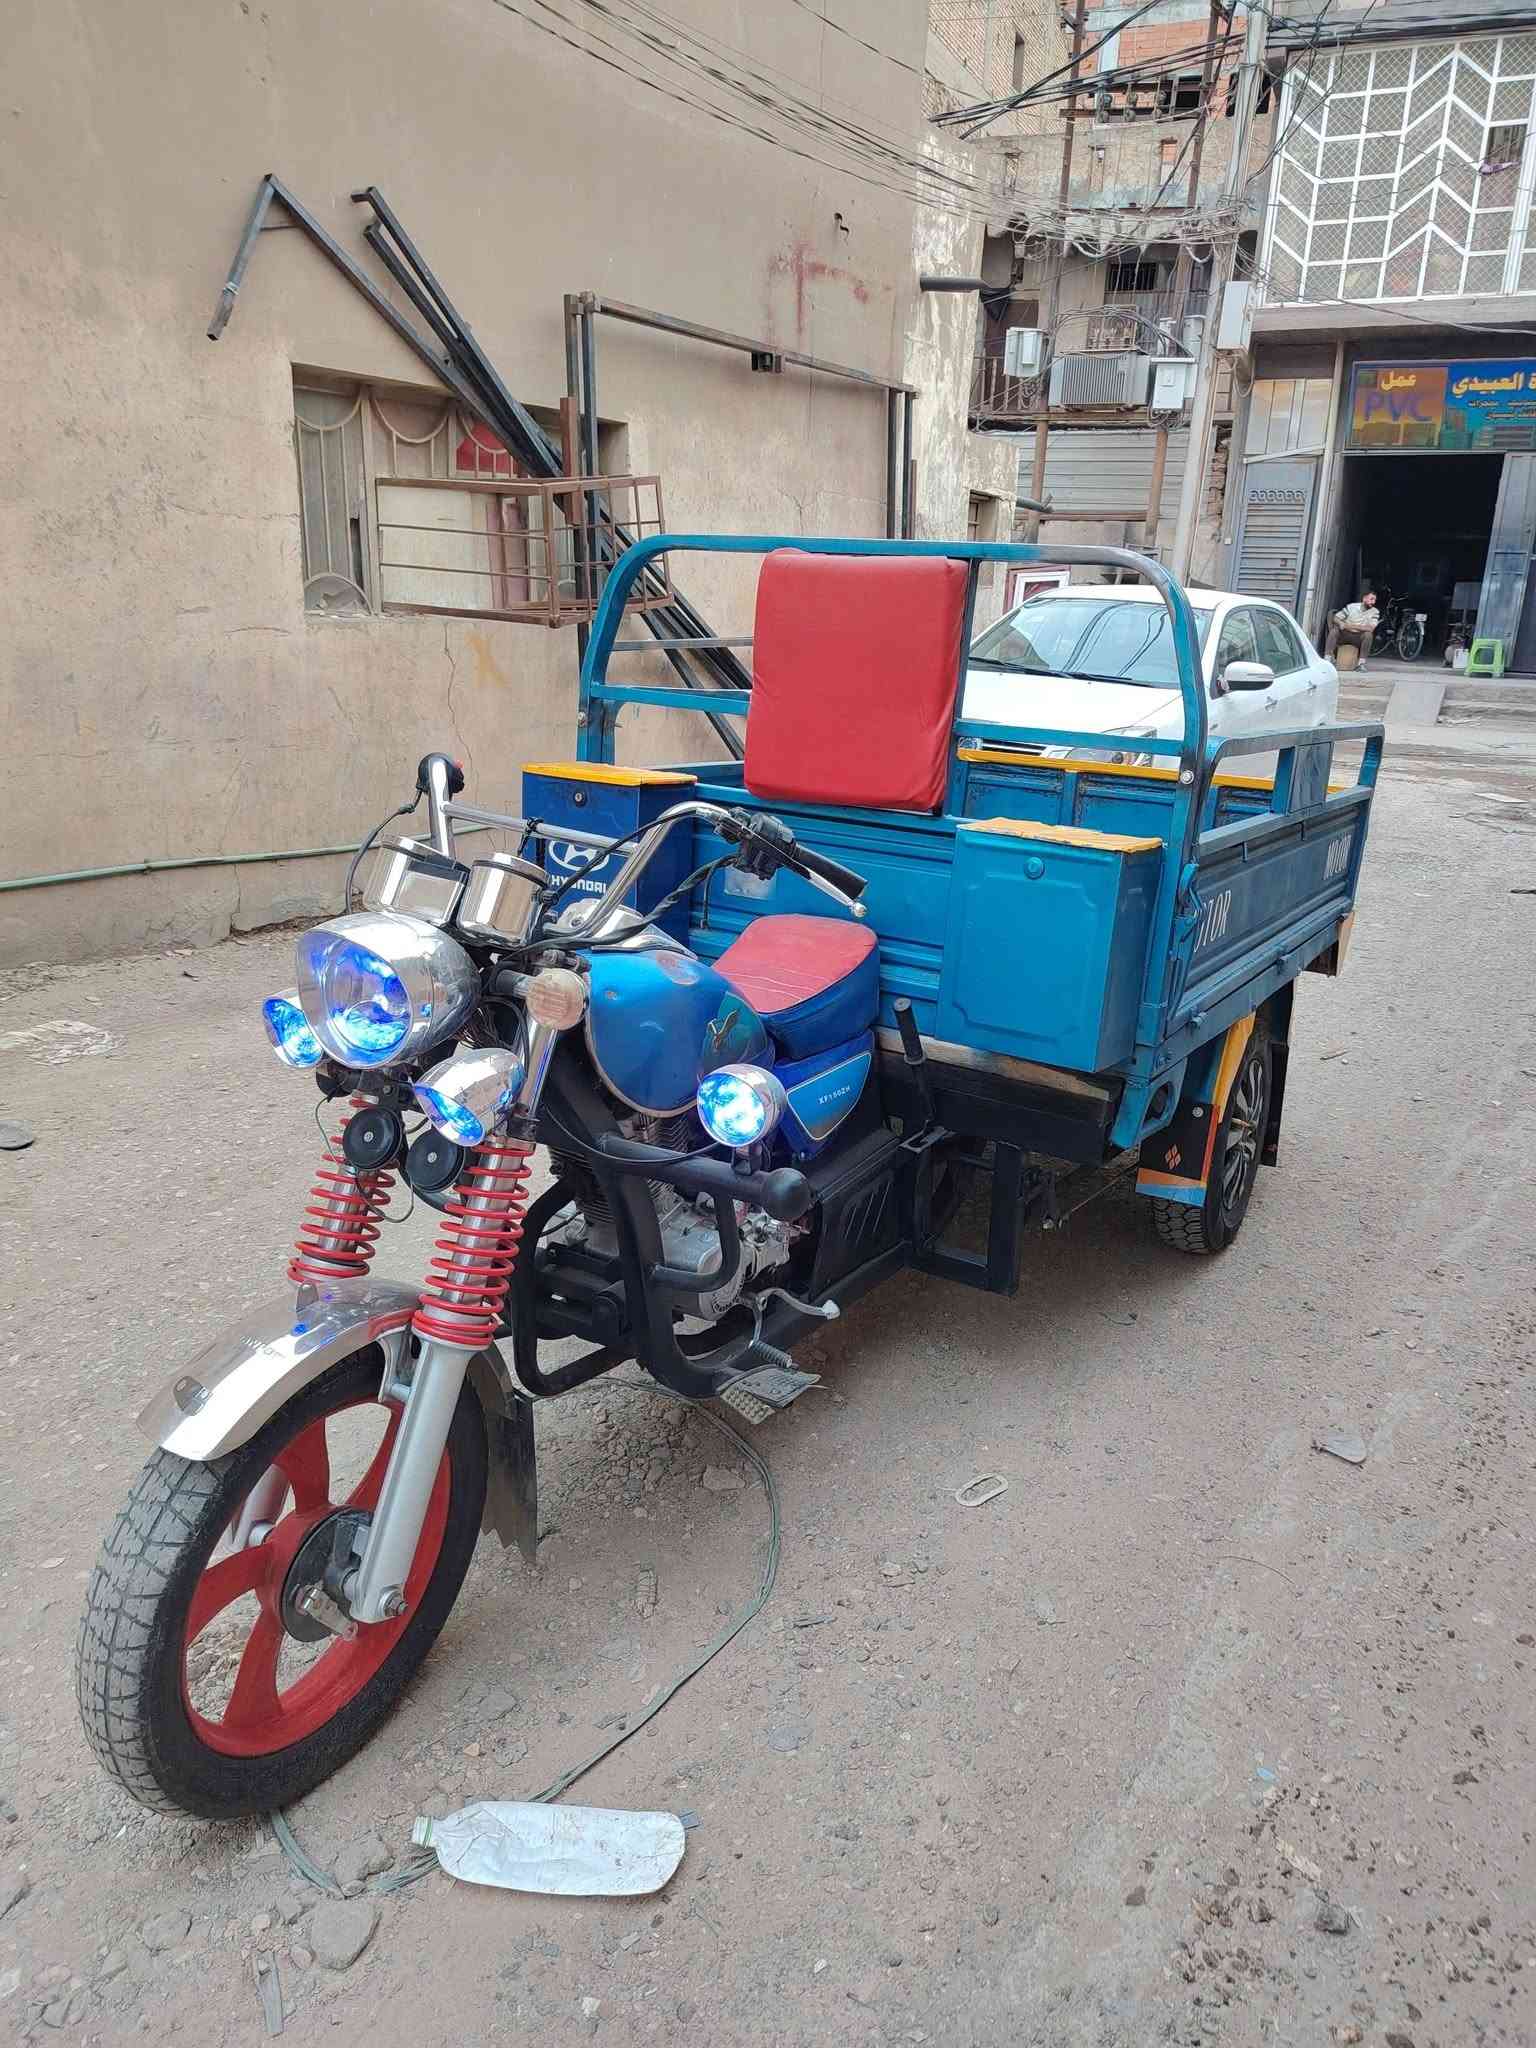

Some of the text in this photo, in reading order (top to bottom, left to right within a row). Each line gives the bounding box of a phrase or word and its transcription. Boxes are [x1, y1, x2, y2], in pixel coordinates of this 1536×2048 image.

[1381, 371, 1416, 391] عمل
[1452, 371, 1524, 398] العبيدي
[1364, 391, 1432, 422] PVC
[551, 874, 607, 896] HYNDAI
